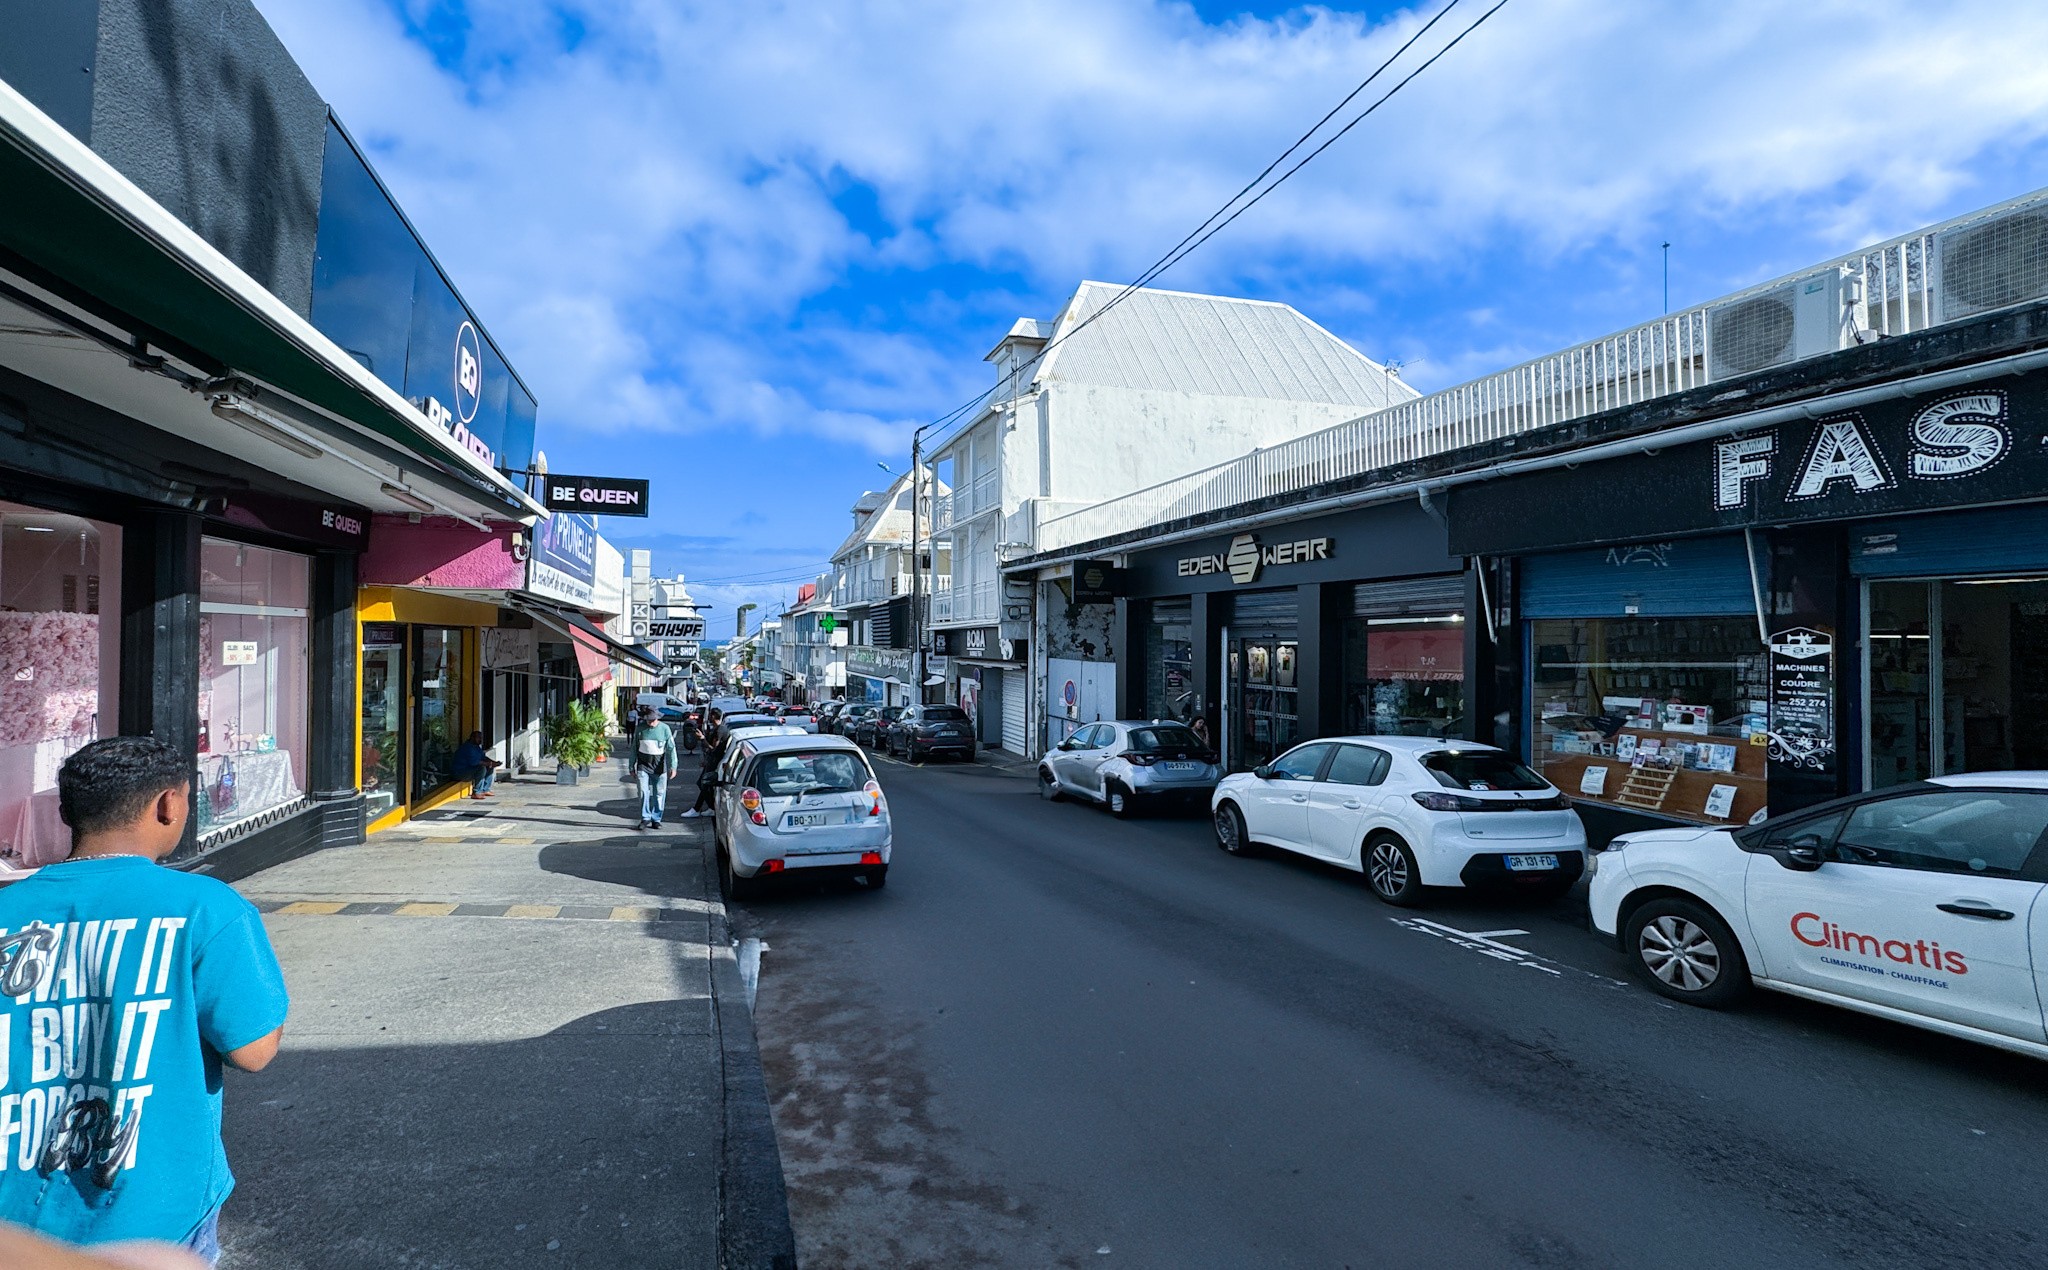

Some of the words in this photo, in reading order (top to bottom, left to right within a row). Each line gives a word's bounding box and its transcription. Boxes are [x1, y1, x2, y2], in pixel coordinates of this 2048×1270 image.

[460, 346, 477, 398] BQ
[1716, 393, 2005, 507] FAS
[552, 487, 576, 502] BE
[579, 488, 639, 505] QUEEN
[322, 510, 334, 528] BE
[335, 514, 362, 535] QUEEN
[556, 513, 592, 565] PRUNELLE
[1177, 552, 1224, 577] EDEN
[1262, 537, 1329, 566] WEAR
[680, 647, 697, 656] SHOP
[966, 629, 986, 647] BOBA
[1779, 645, 1817, 654] Fas
[1776, 664, 1826, 672] MACHINES
[1780, 680, 1821, 688] COUDRE
[1789, 698, 1806, 706] 252
[1809, 699, 1827, 707] 274
[135, 917, 188, 996] IT
[1790, 912, 1969, 975] Climatis
[1820, 955, 1884, 976] CLIMATISATION
[1890, 970, 1949, 990] CHAUFFAGE
[31, 1002, 111, 1084] BUY
[111, 998, 172, 1083] IT
